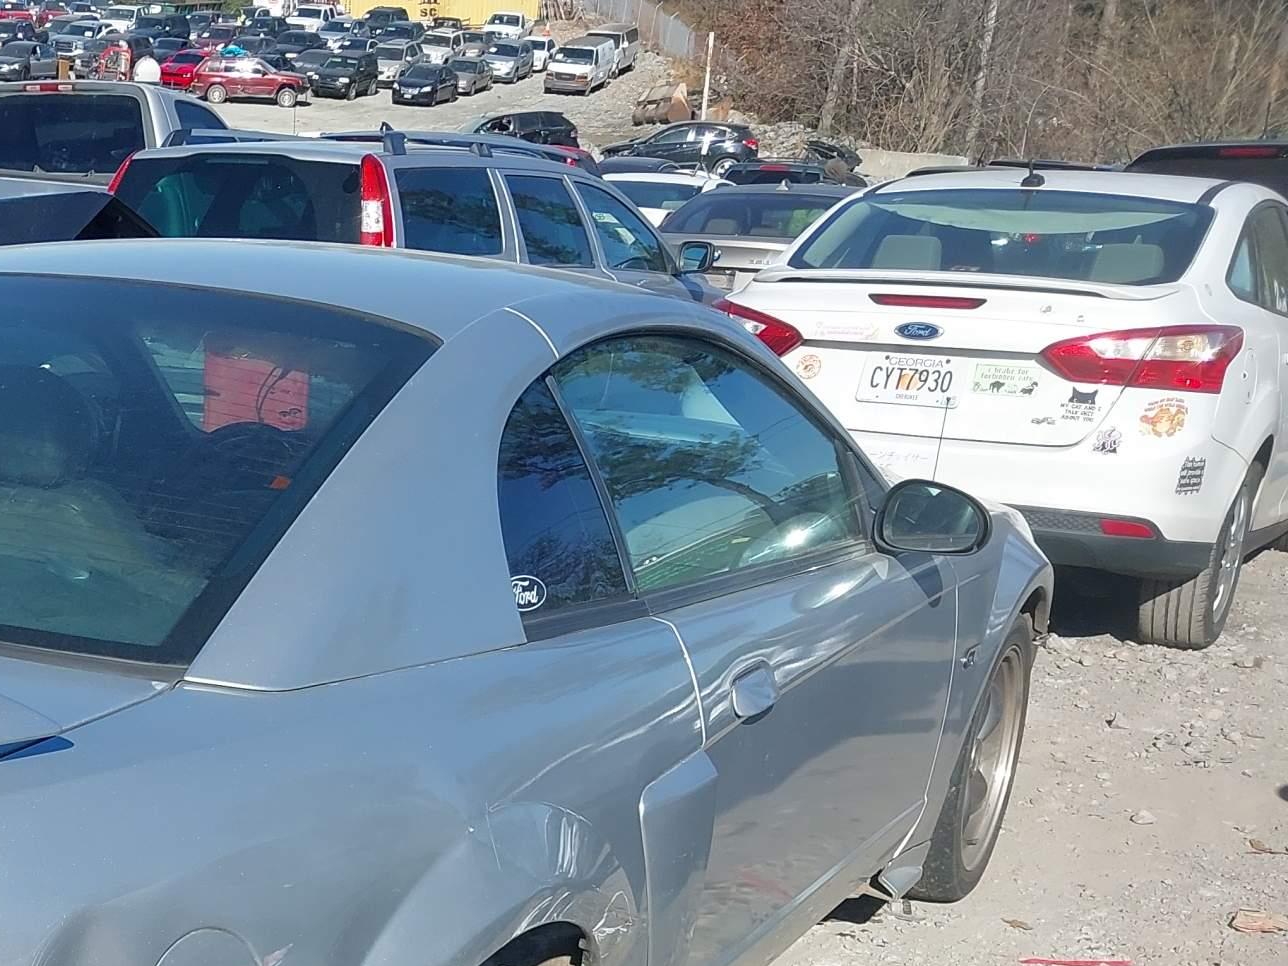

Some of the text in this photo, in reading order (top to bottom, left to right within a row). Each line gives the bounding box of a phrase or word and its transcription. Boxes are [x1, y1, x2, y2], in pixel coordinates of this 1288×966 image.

[904, 324, 931, 337] Ford
[889, 356, 944, 368] GEORGIA
[870, 366, 953, 393] CYT7930
[512, 580, 539, 605] Ford
